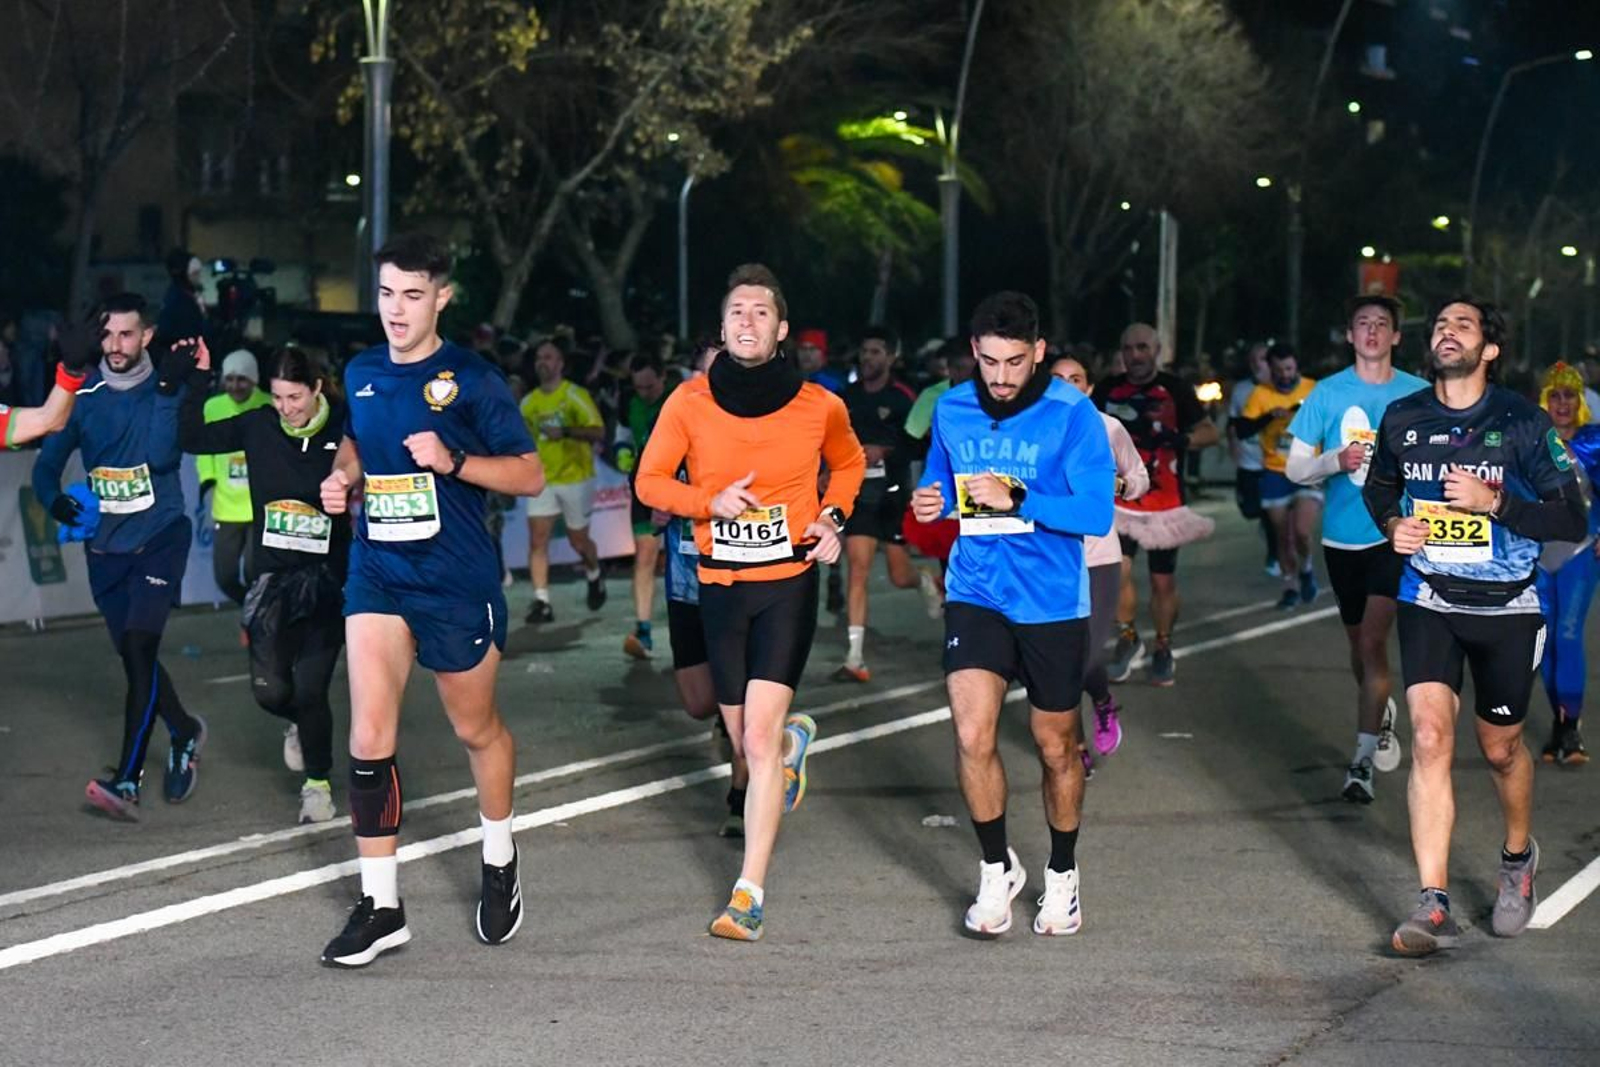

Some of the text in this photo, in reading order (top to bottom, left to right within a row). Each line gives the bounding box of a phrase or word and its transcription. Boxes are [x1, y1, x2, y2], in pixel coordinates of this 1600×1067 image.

[959, 437, 1039, 466] UCAM
[1403, 460, 1504, 484] SAN ATÓN
[96, 479, 146, 497] 1013
[367, 492, 430, 517] 2053
[271, 511, 325, 535] 1129
[714, 519, 784, 540] 10167
